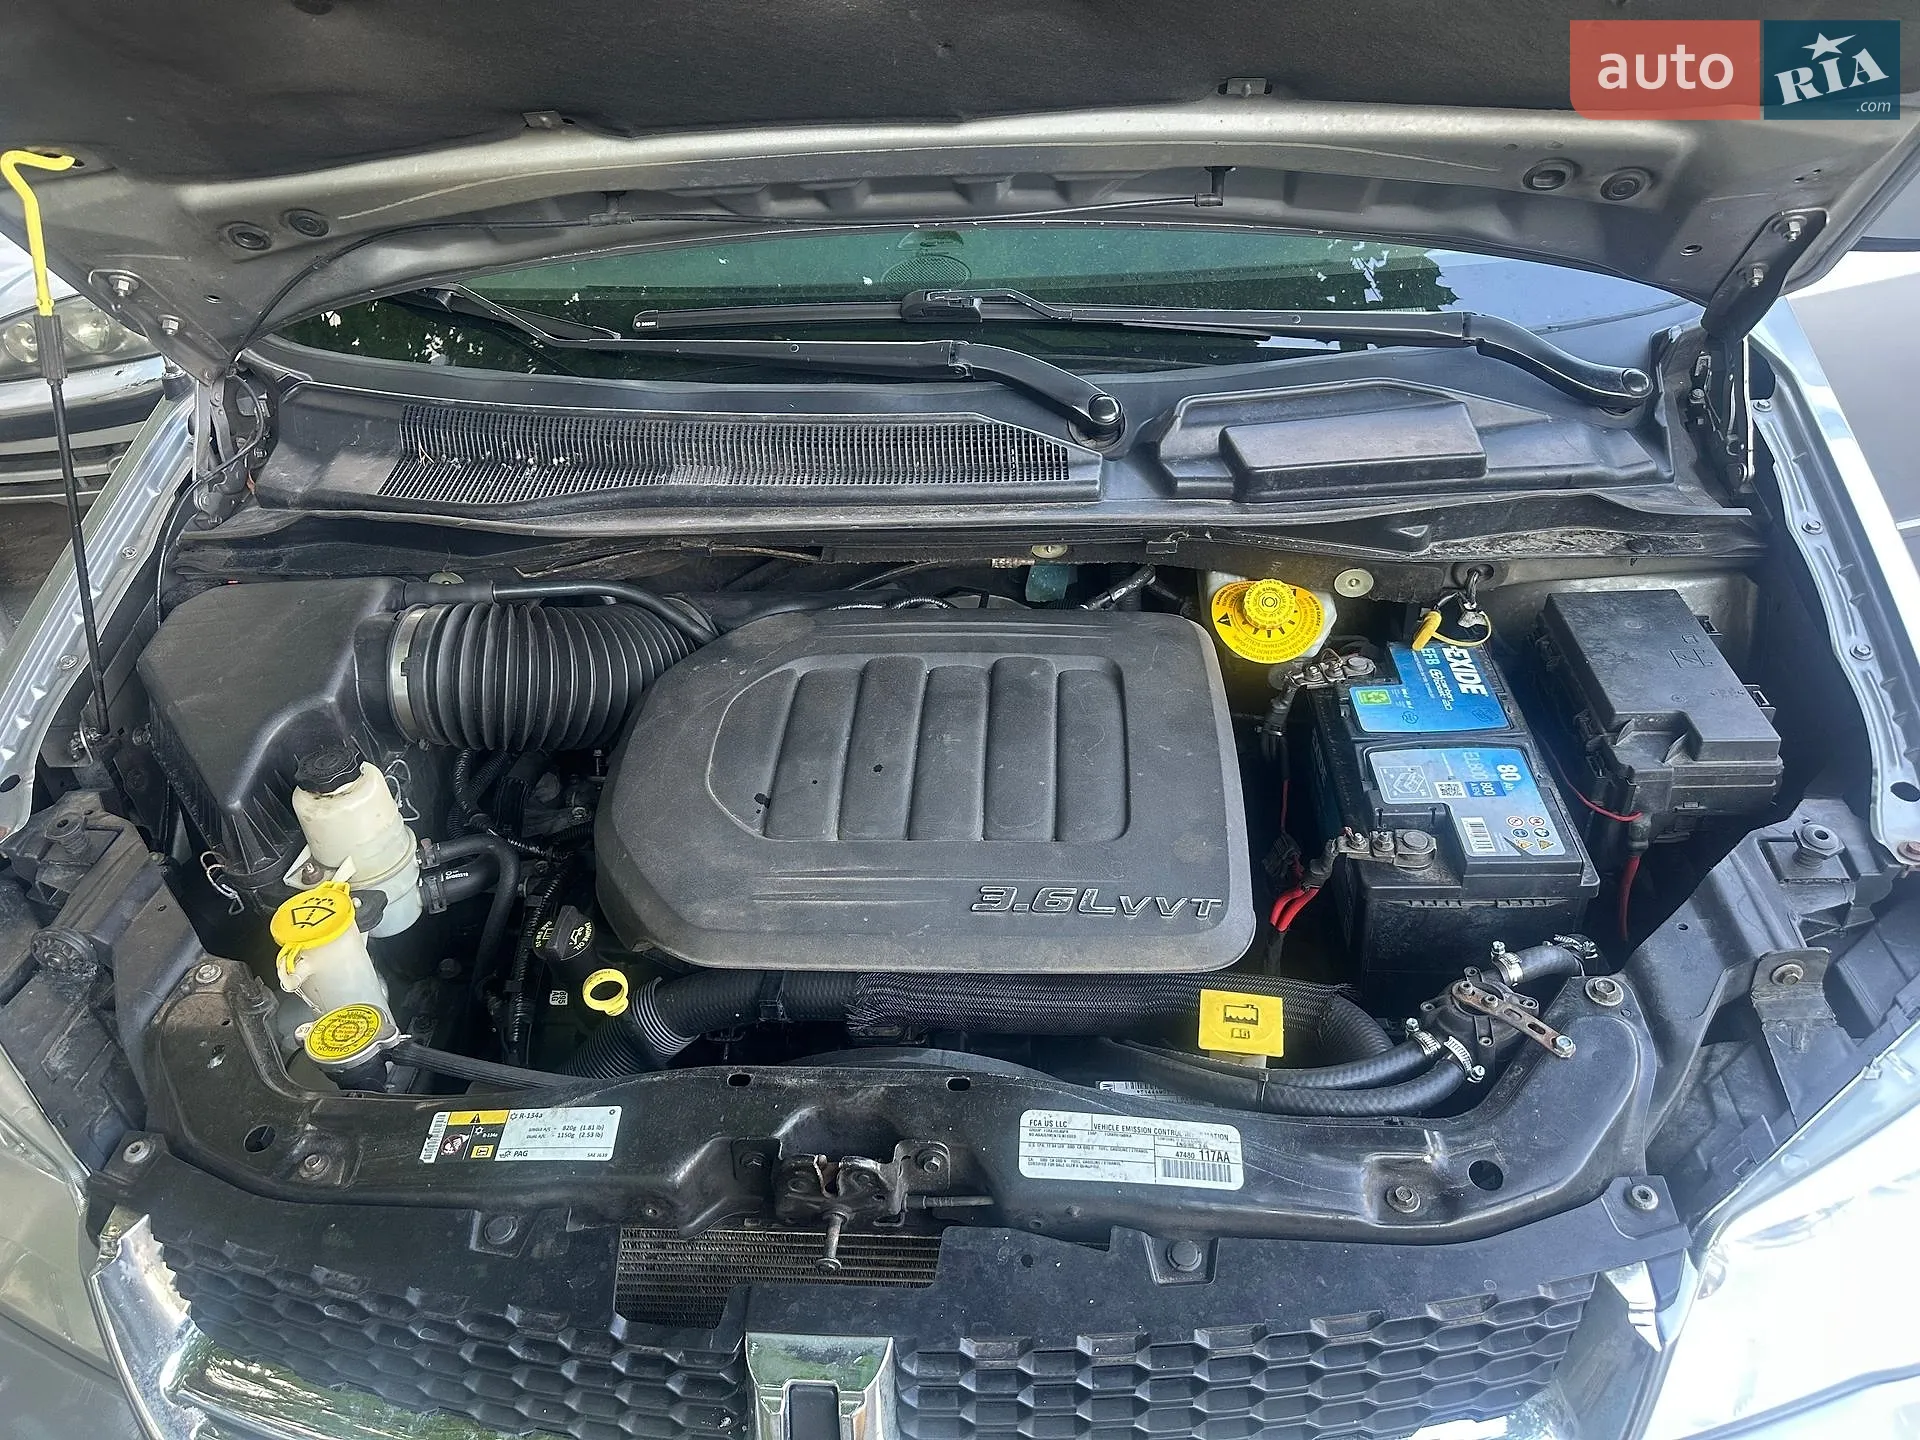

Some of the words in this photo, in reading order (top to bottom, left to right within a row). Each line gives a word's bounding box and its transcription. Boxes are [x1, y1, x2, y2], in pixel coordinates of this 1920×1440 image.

[1421, 648, 1440, 665] EFB
[1442, 645, 1488, 696] EXIDE
[1497, 764, 1522, 781] 80
[1480, 782, 1496, 796] 800
[971, 886, 1117, 915] 3.6L
[1119, 895, 1223, 919] VVT
[580, 1124, 595, 1132] (1.81
[1029, 1119, 1042, 1127] FCA
[1045, 1120, 1054, 1128] US
[1055, 1120, 1068, 1128] LLC
[1093, 1123, 1120, 1132] VEHICLE
[1122, 1125, 1152, 1134] EMISSION
[579, 1131, 594, 1139] (2.53
[1199, 1150, 1231, 1163] 117AA
